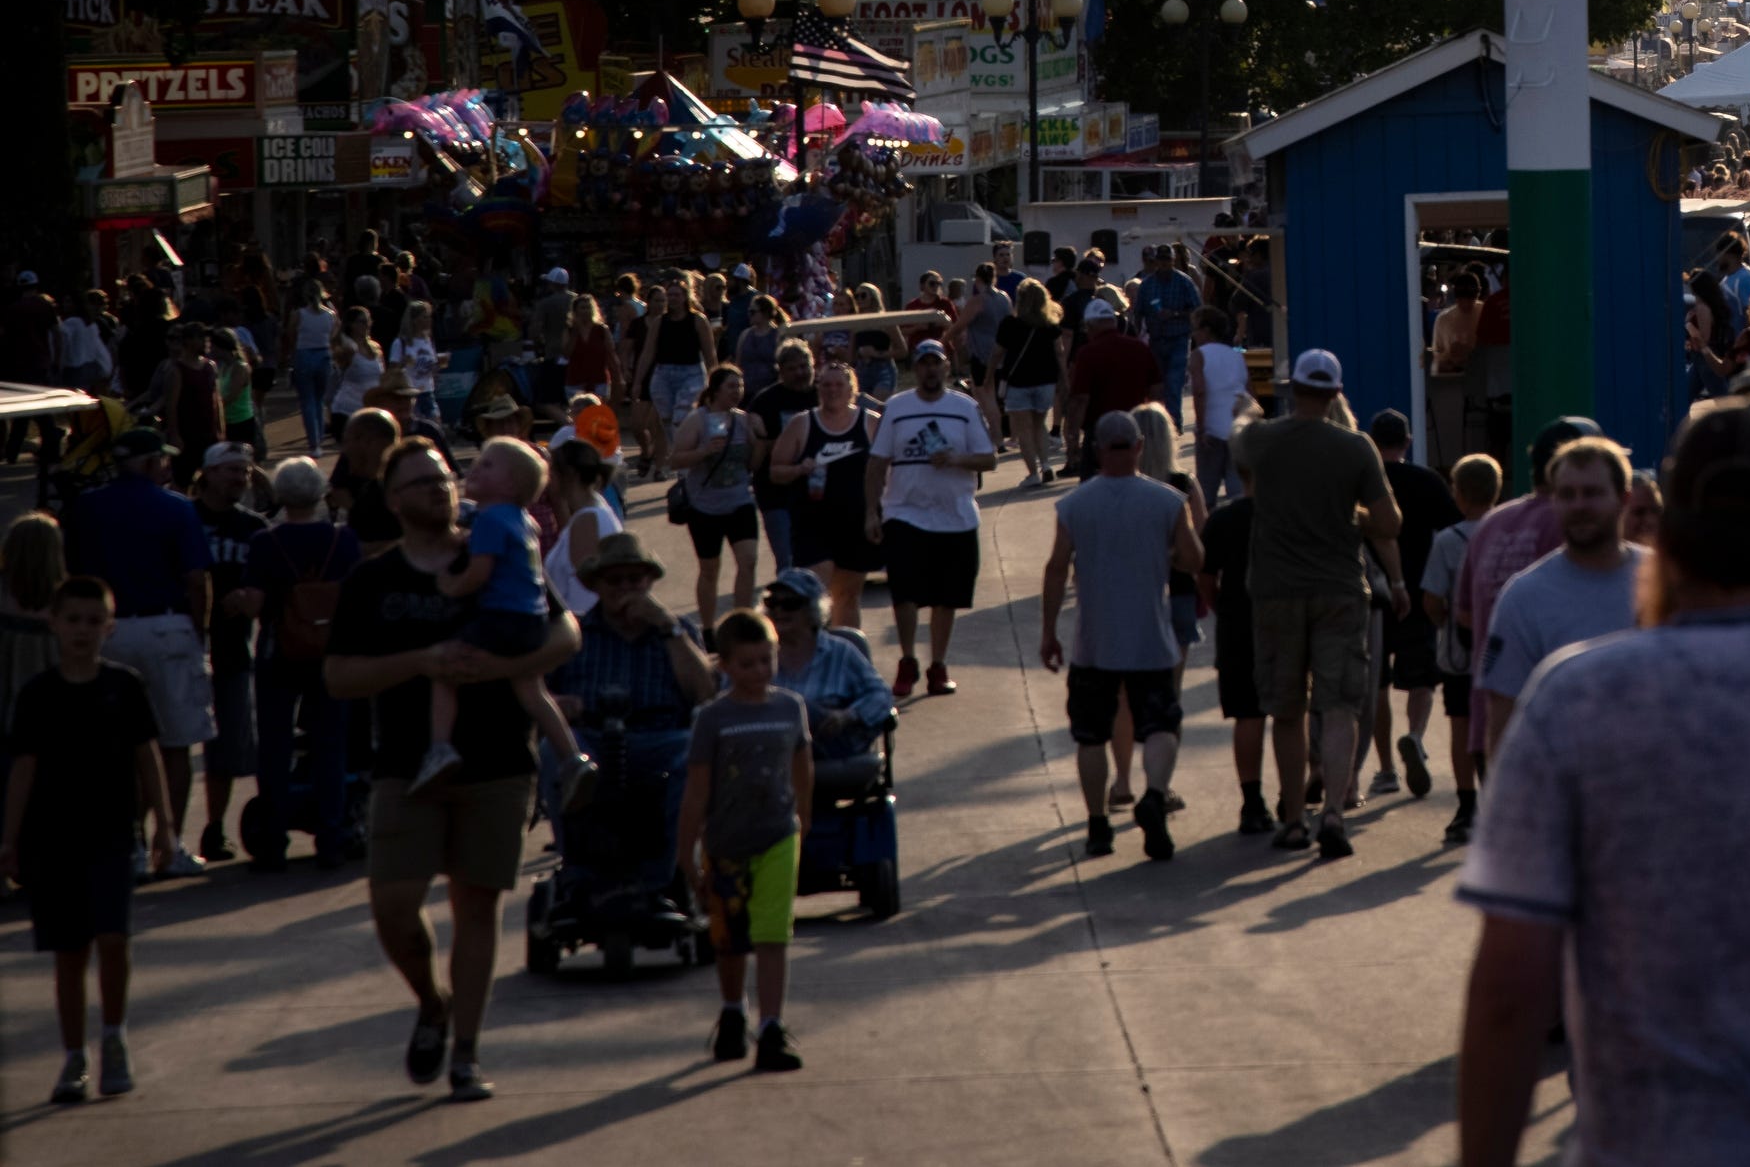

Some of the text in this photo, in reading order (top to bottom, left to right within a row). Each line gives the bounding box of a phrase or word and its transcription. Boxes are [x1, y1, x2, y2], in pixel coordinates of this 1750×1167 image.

[937, 1, 1021, 31] LONS
[1023, 117, 1080, 132] PCKLE
[263, 137, 335, 158] ICE COL
[1036, 134, 1070, 146] AWG
[901, 151, 964, 167] Drinks
[904, 446, 929, 458] adi
